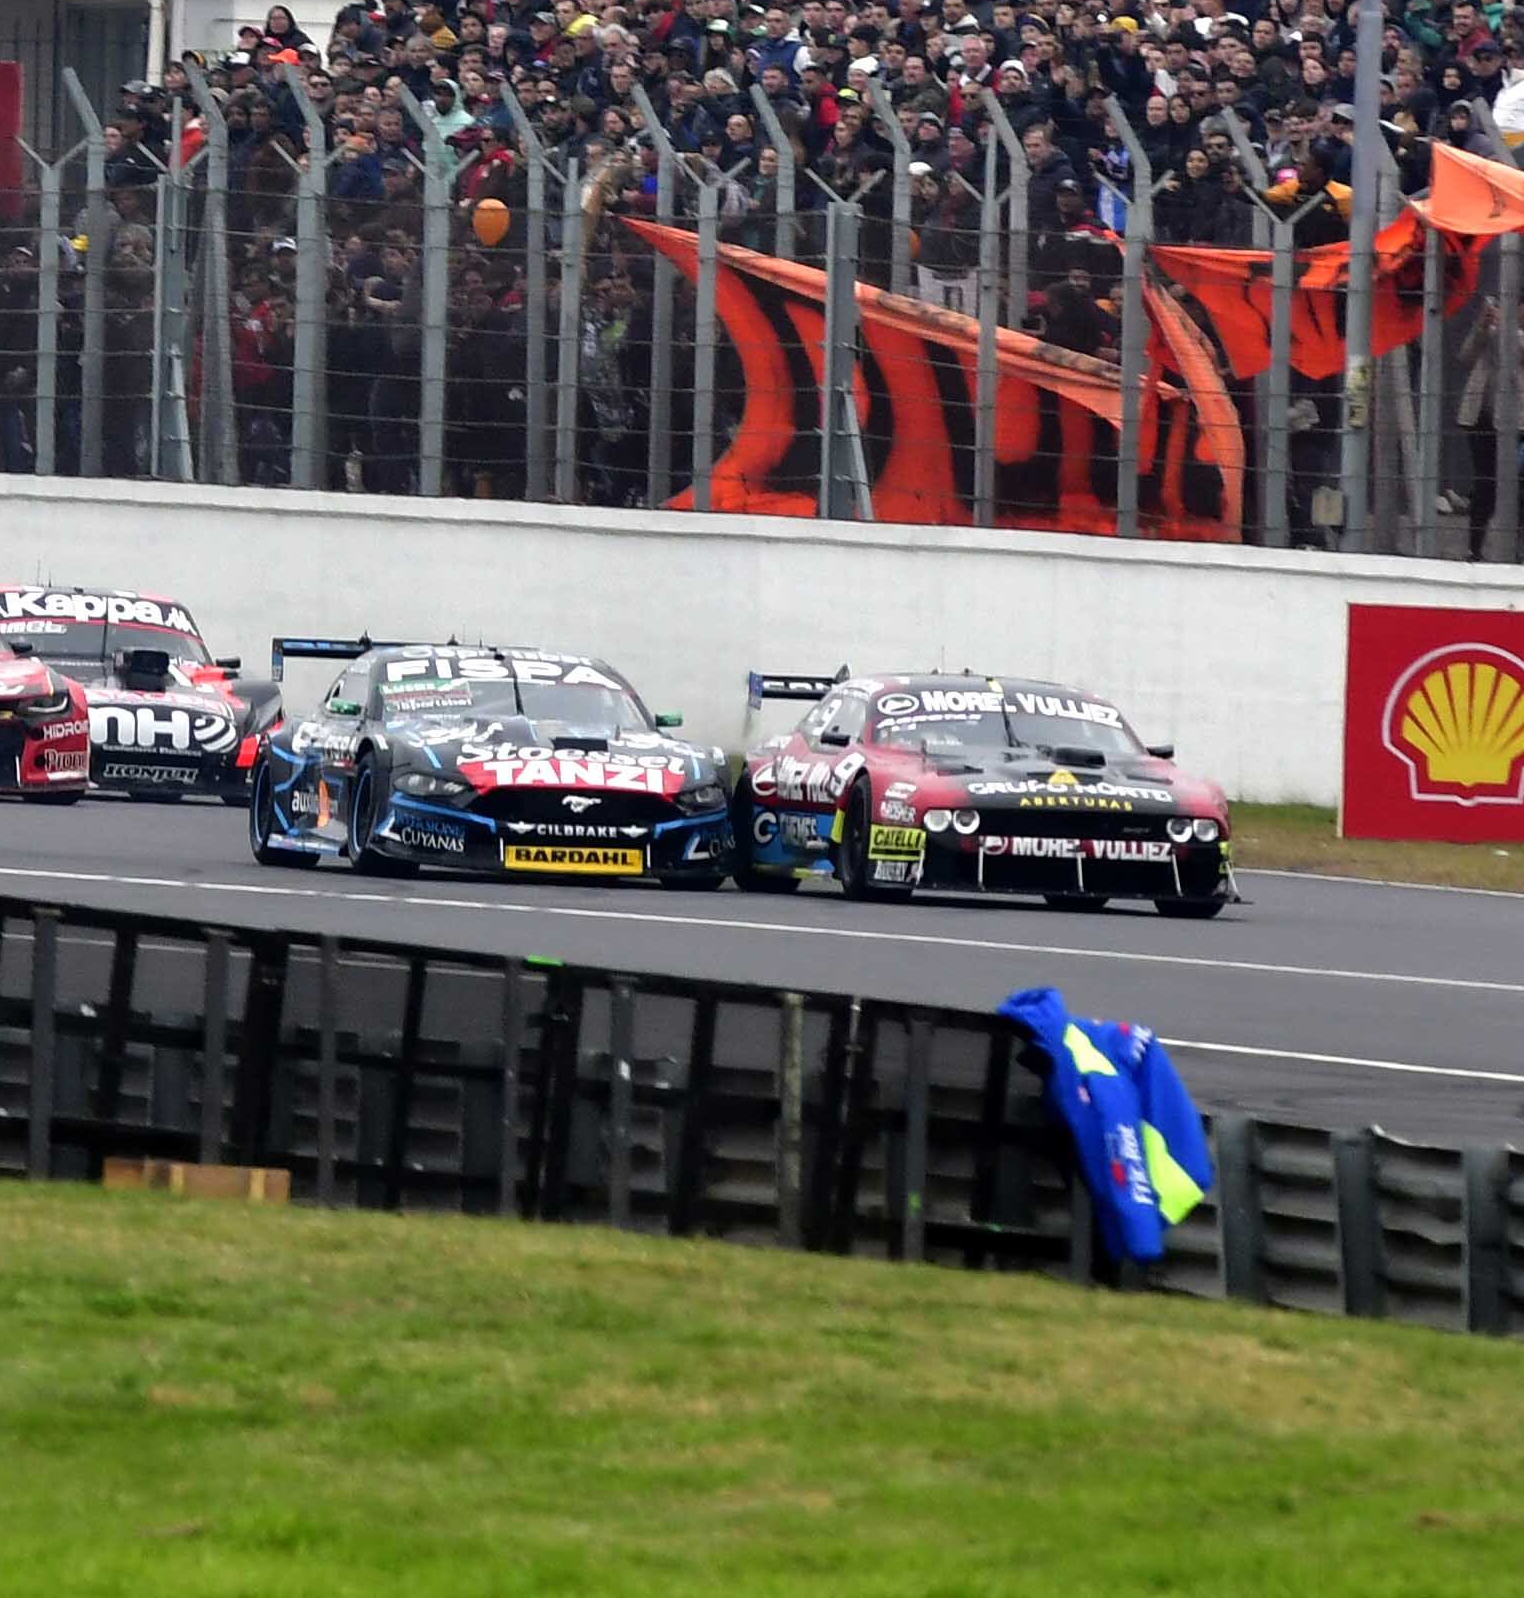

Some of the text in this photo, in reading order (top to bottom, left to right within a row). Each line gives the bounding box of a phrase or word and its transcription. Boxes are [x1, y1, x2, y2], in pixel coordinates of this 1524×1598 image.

[0, 592, 164, 625] Kappa
[387, 657, 623, 691] FISPA
[1017, 691, 1124, 729] VULLIEZ
[483, 758, 666, 795] TANZI
[1019, 795, 1133, 812] ABERTURAS
[402, 826, 465, 853] CUYANAS
[536, 822, 618, 839] CILBRAKE
[514, 848, 634, 867] BARDAHL
[1092, 839, 1172, 863] VULLIEZ
